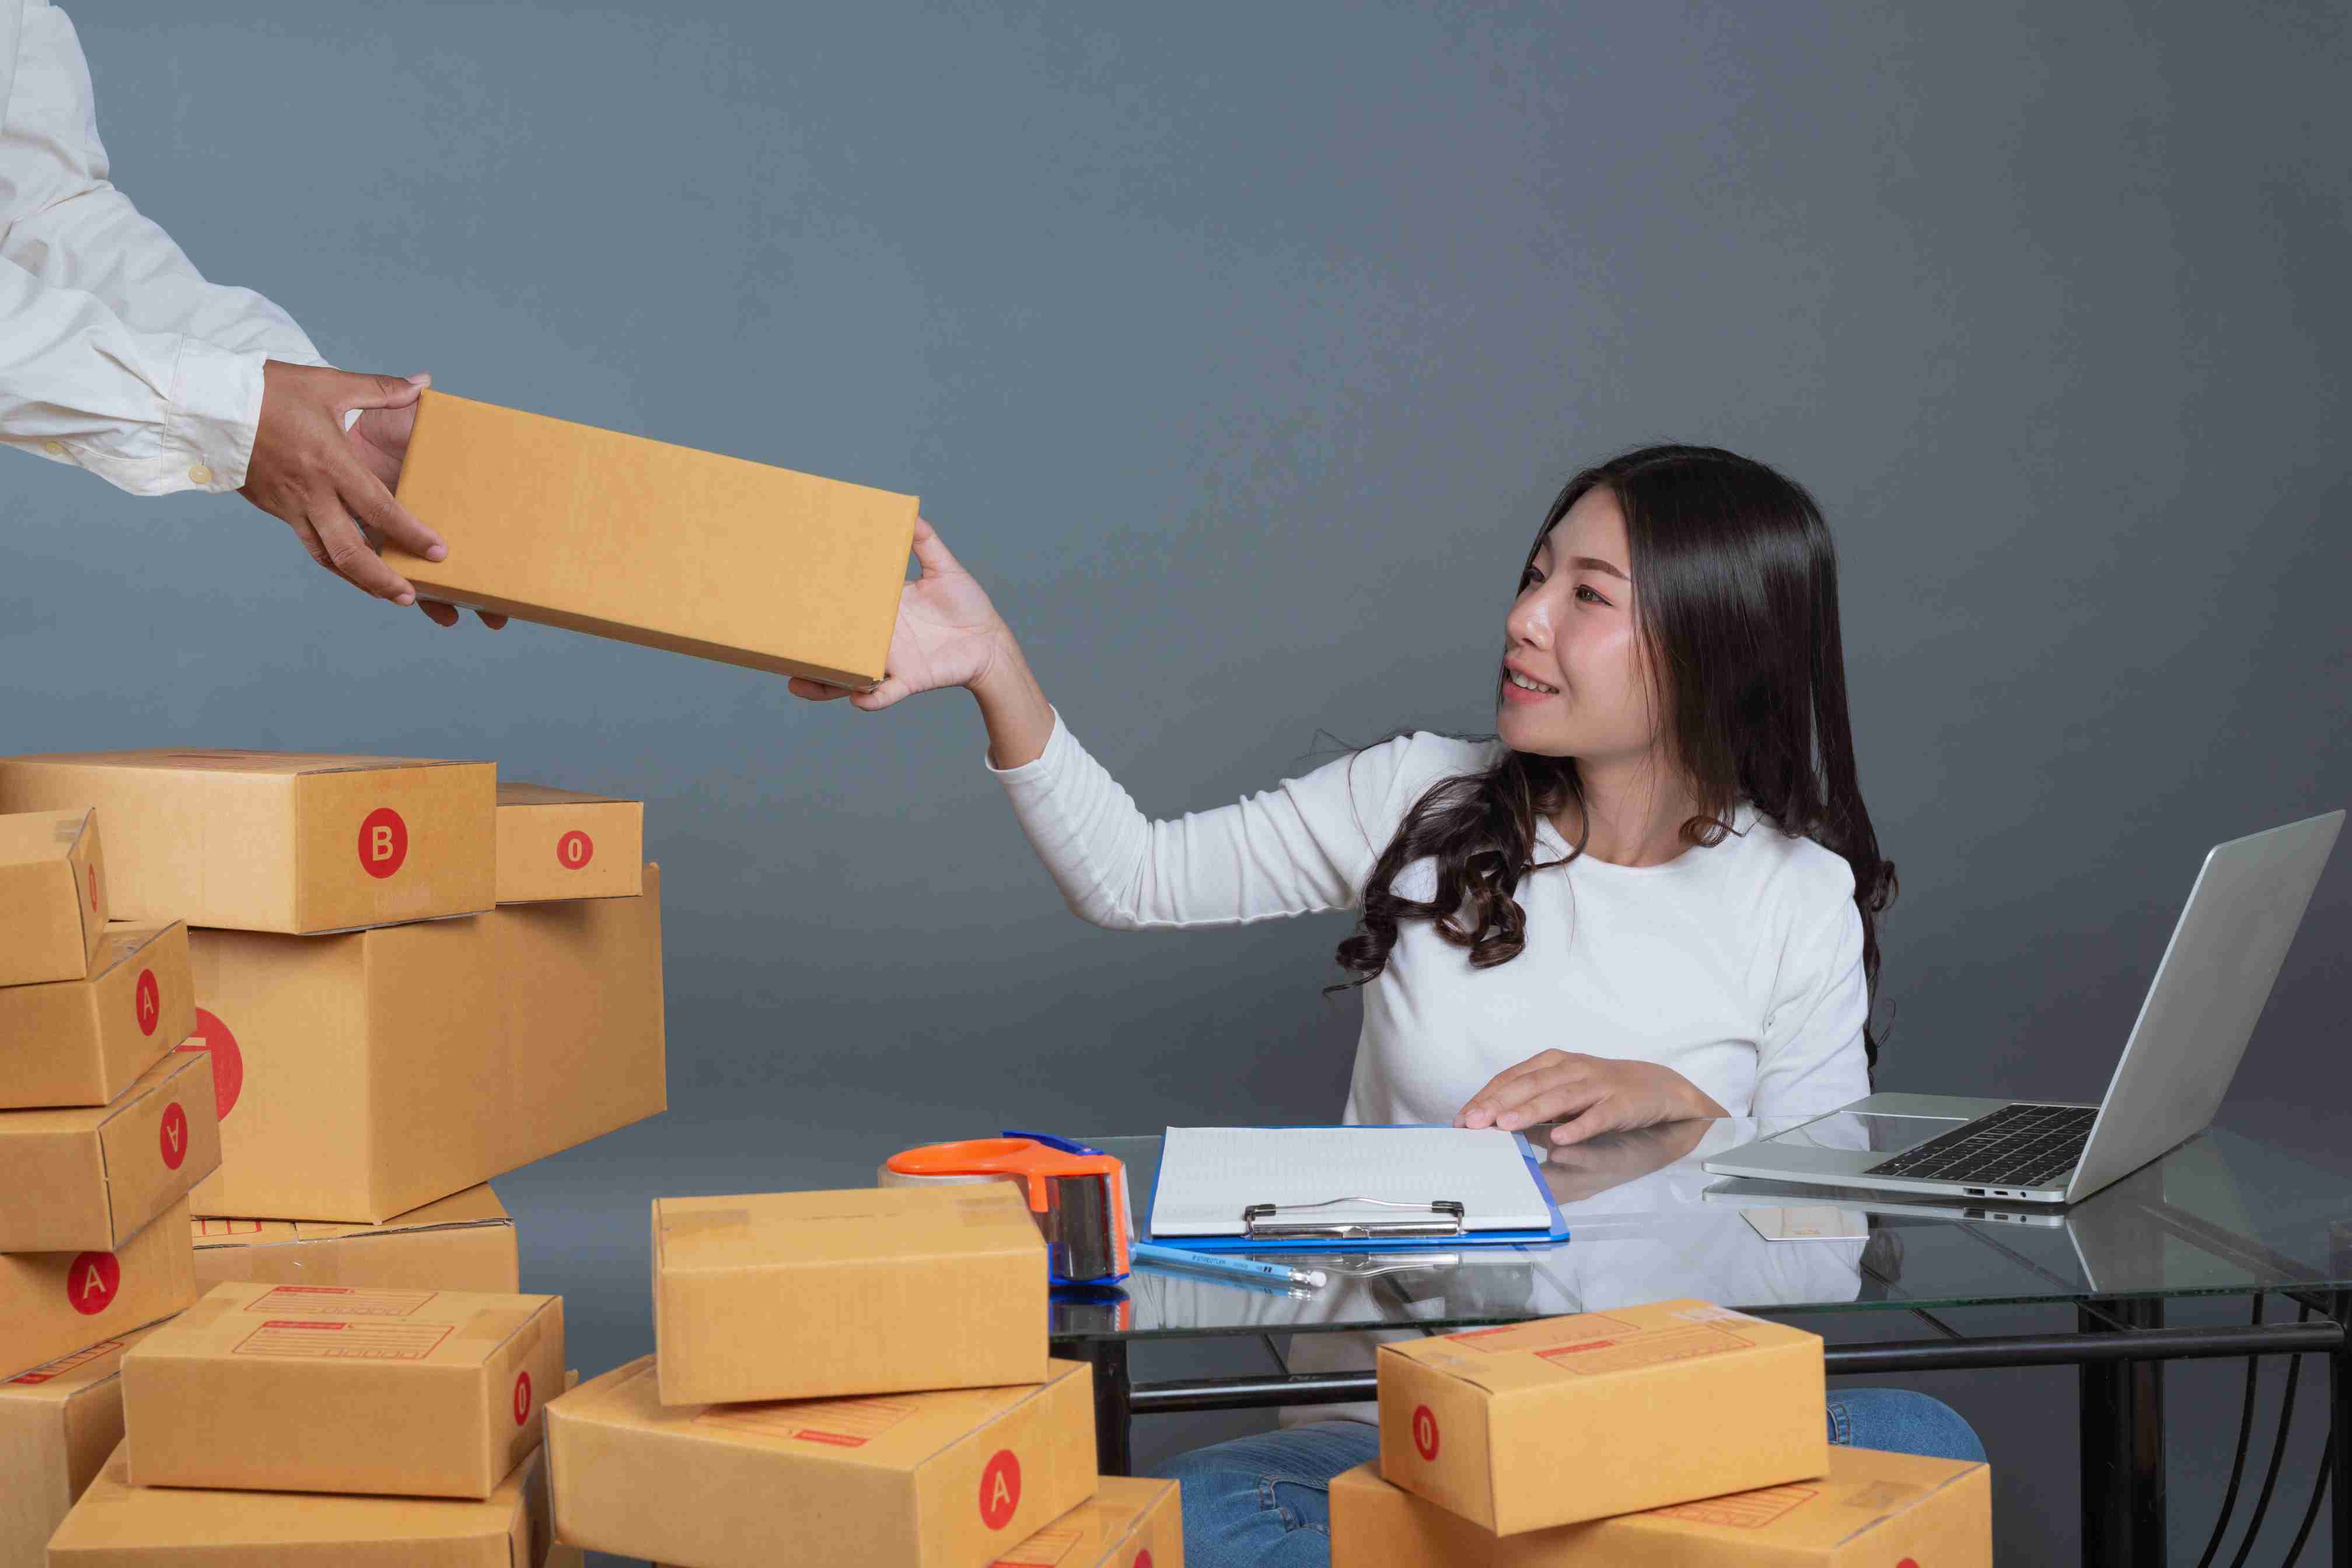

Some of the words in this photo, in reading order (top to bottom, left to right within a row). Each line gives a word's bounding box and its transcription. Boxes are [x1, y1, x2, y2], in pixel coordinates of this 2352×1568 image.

[373, 825, 393, 862] B
[144, 986, 153, 1021] A
[166, 1118, 178, 1153] A
[83, 1264, 106, 1300] A
[989, 1470, 1009, 1513] A
